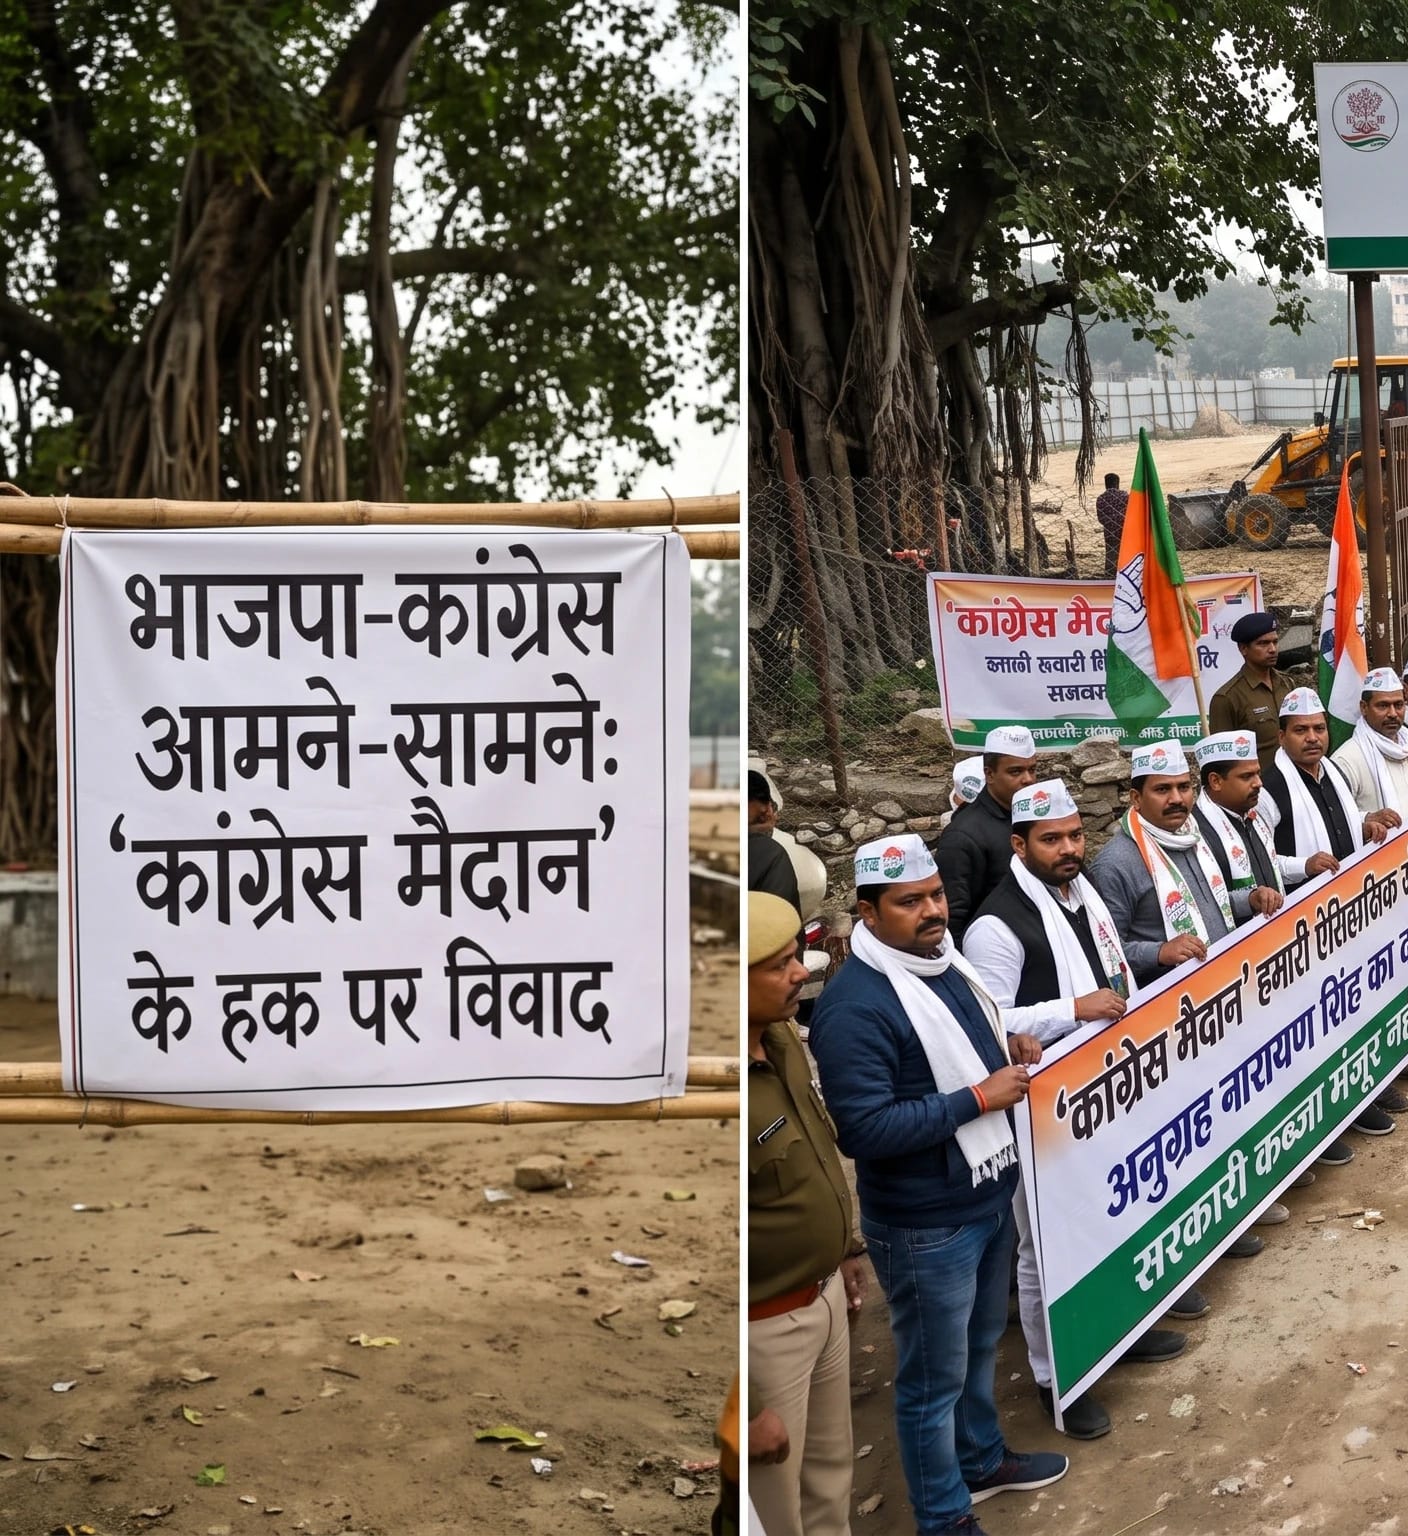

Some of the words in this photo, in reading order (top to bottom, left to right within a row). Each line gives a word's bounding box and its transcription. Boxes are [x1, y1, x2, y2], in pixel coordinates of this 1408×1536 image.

[125, 544, 621, 661] भाजपा-कांग्रेस
[946, 595, 1058, 642] ‘कांग्रेस
[135, 673, 618, 792] आमने-सामने:
[110, 809, 367, 929] ‘कांग्रेस
[394, 796, 615, 922] मैदान’
[127, 951, 194, 1053] के
[216, 971, 320, 1063] हक
[343, 968, 421, 1045] पर
[445, 937, 612, 1044] विवाद
[1056, 1031, 1168, 1140] ‘कांग्रेस
[1174, 962, 1248, 1061] मैदान’
[1256, 917, 1310, 1006] हमारी
[1107, 1088, 1214, 1218] अनुग्रह
[1219, 1004, 1315, 1113] नारायण
[1368, 940, 1395, 991] का
[1133, 1149, 1249, 1293] सरकारी
[1254, 1085, 1325, 1178] कब्जा
[1329, 1028, 1382, 1093] मंजूर
